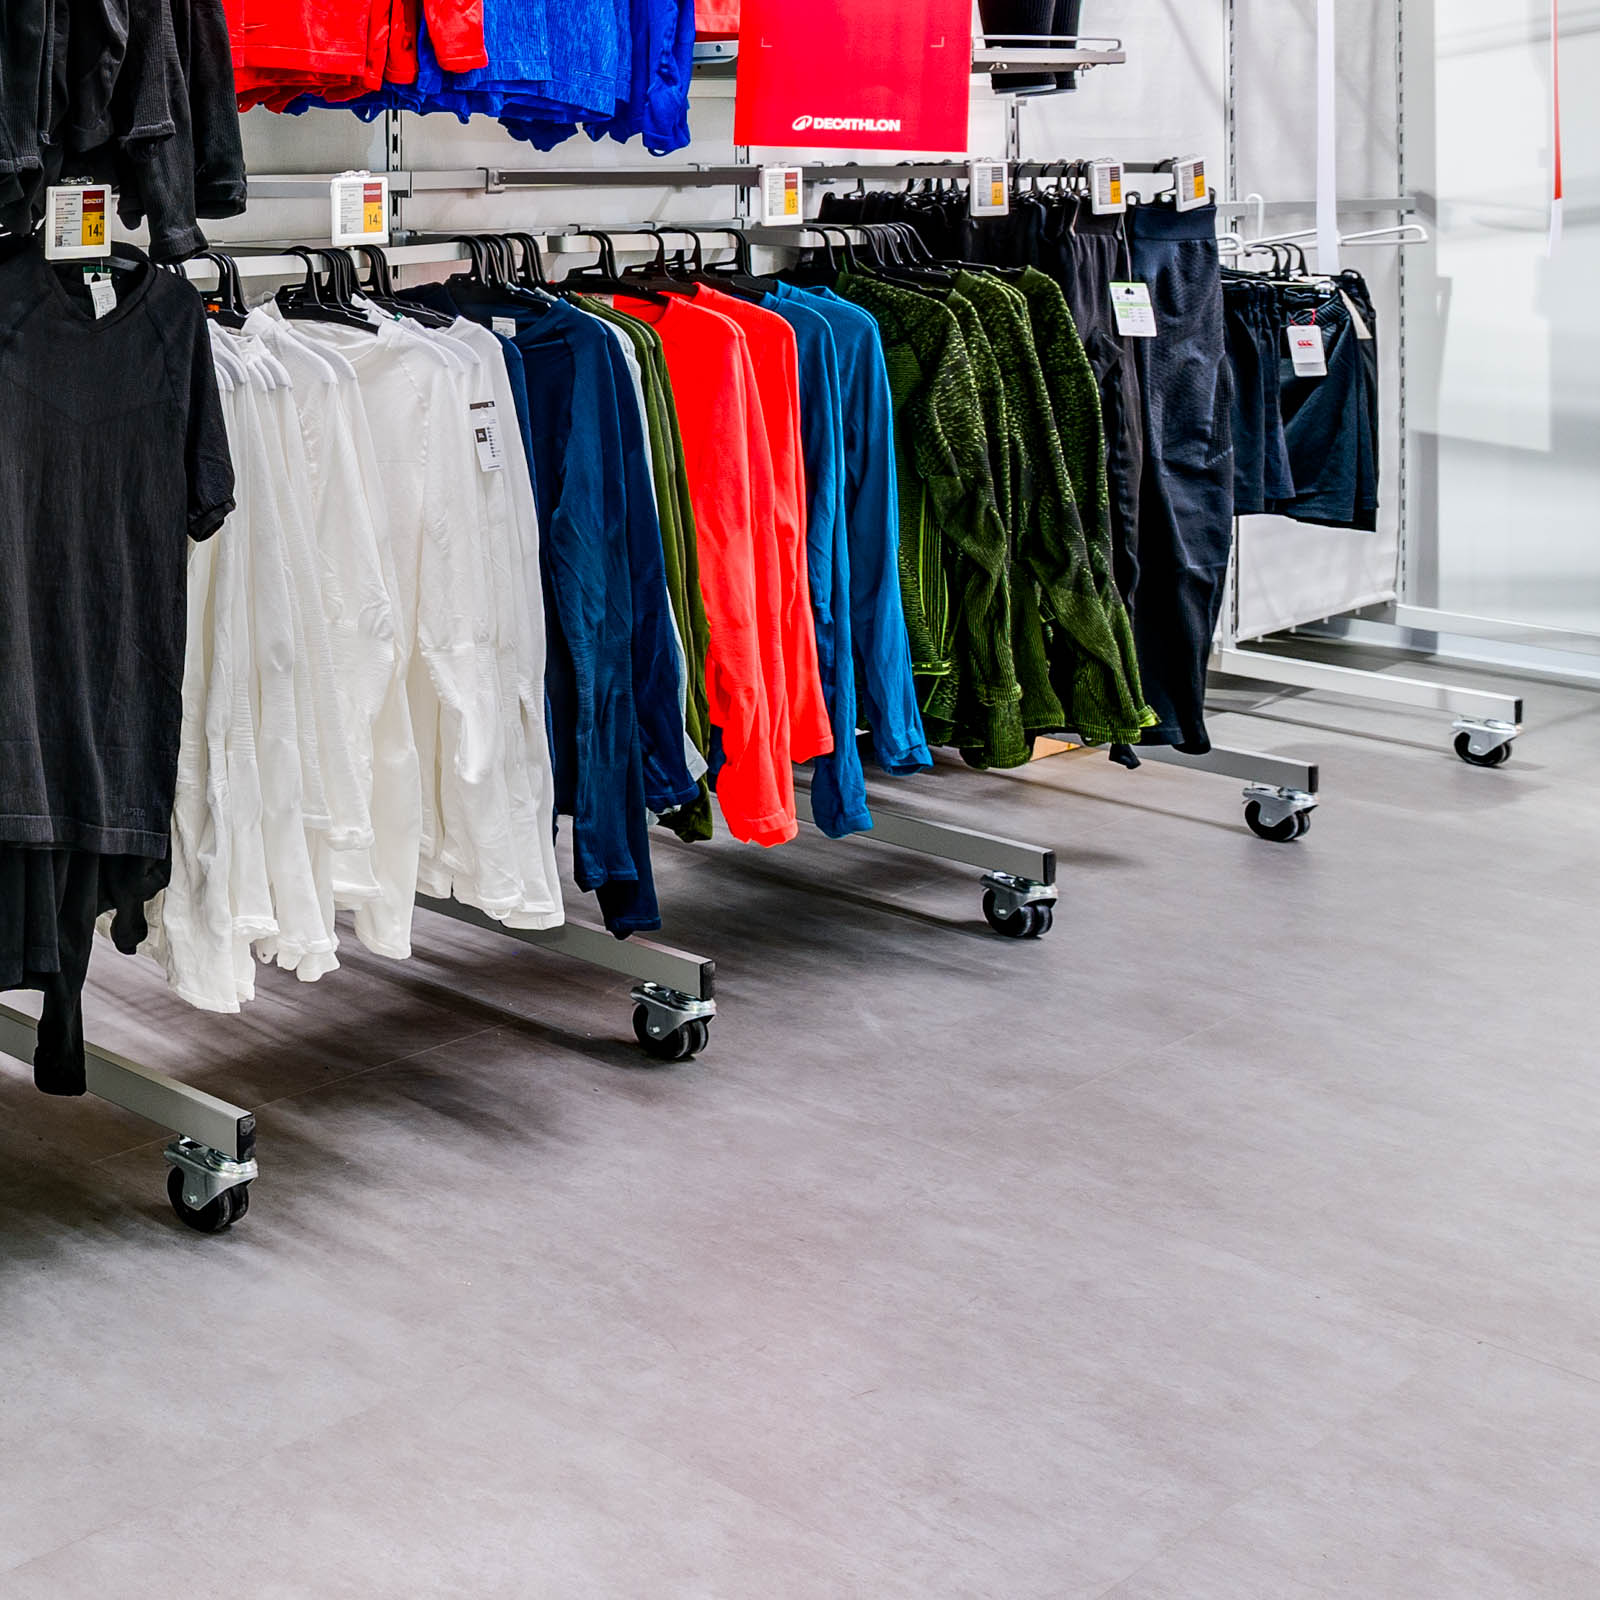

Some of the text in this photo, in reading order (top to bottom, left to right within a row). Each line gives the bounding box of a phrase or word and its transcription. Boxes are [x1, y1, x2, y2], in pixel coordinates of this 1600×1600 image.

[813, 117, 901, 132] DECATHLON
[367, 213, 378, 225] 14
[88, 224, 99, 238] 14
